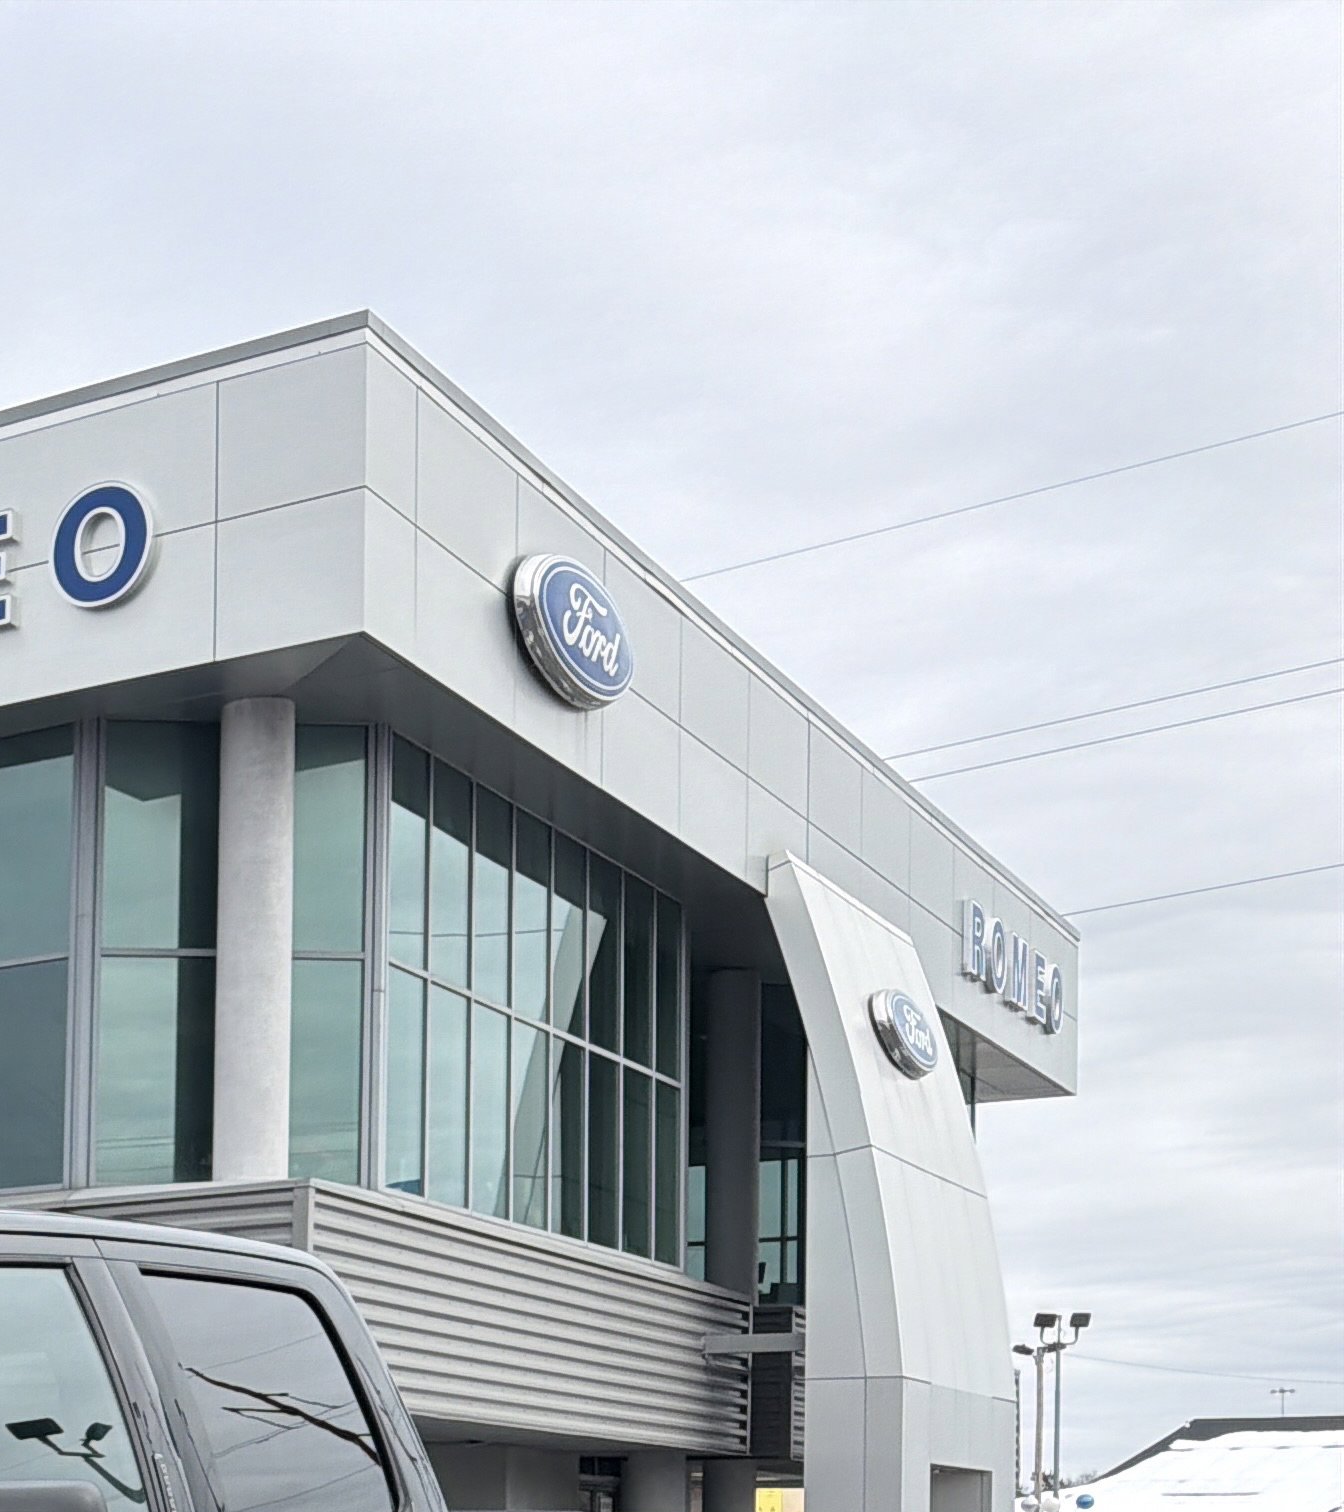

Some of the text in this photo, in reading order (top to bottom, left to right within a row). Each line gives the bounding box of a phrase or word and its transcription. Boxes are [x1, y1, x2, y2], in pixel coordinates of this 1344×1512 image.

[562, 581, 618, 678] Ford
[967, 899, 1064, 1035] ROMEO
[902, 1003, 933, 1057] Ford
